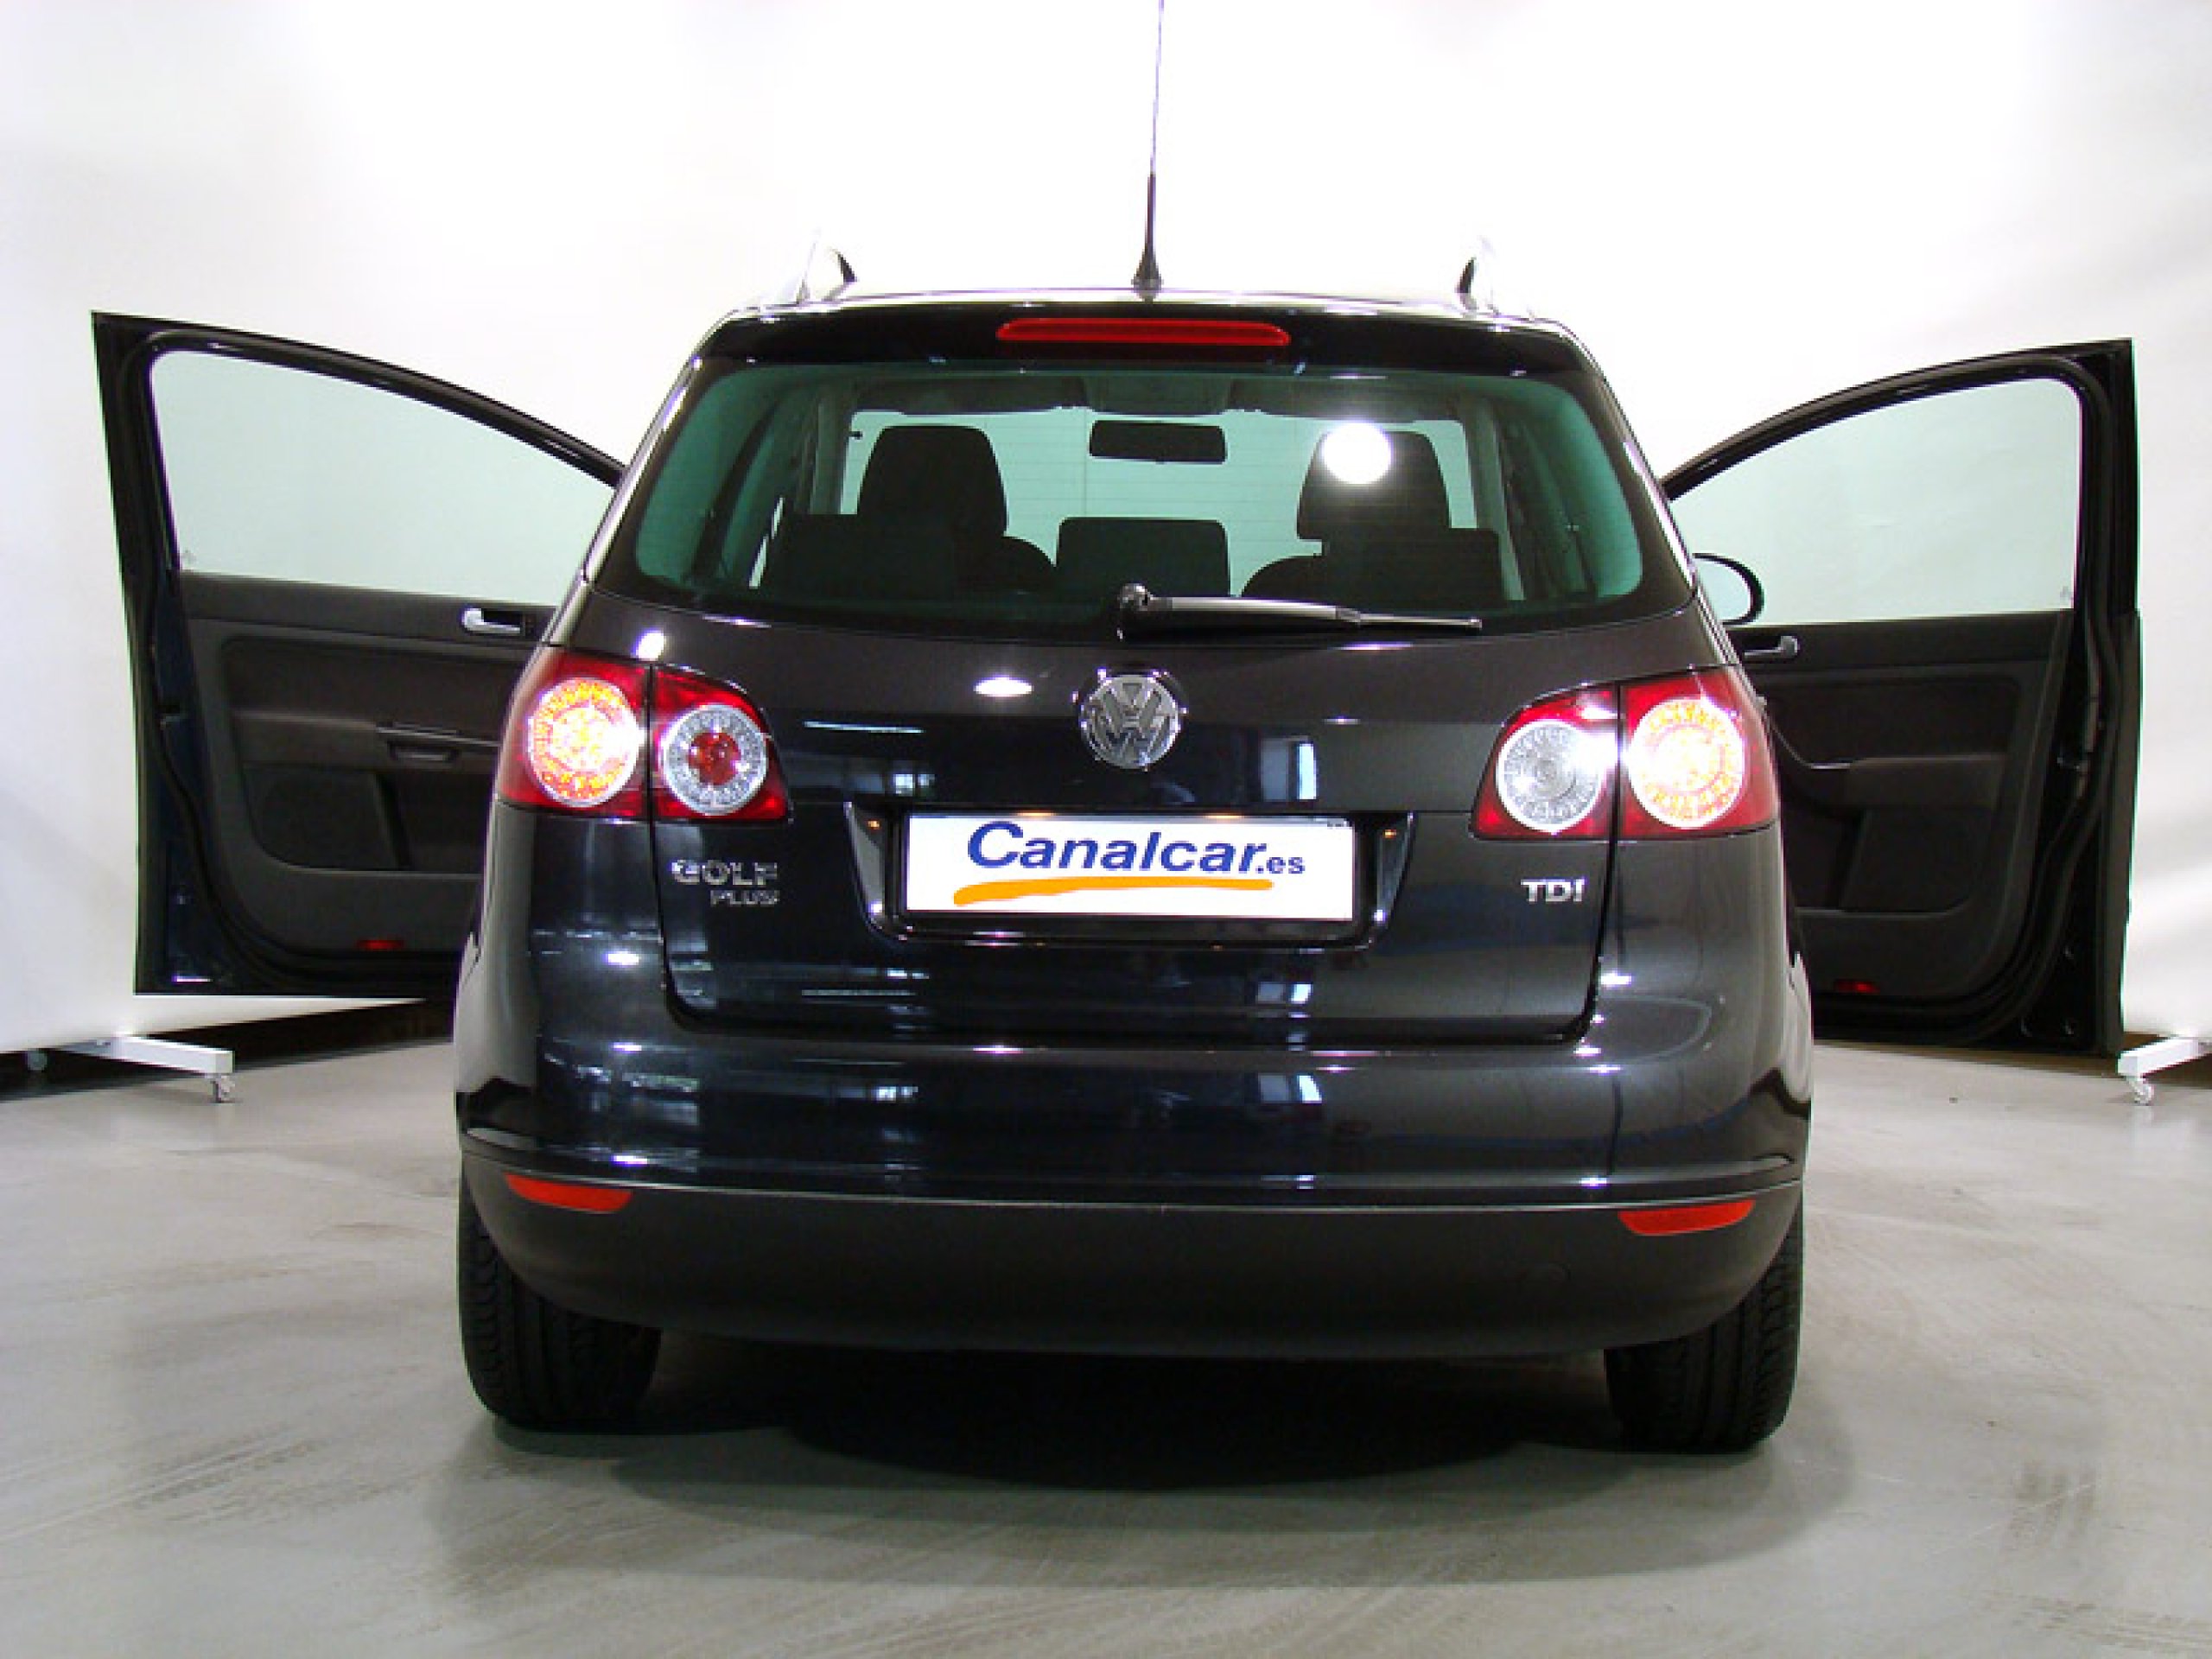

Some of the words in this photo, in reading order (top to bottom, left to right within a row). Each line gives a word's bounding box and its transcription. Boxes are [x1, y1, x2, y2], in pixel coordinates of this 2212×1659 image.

[968, 821, 1306, 874] Canalcar.es
[671, 859, 778, 886] GOLF
[710, 890, 780, 907] PLUS
[1521, 878, 1586, 903] TDI
